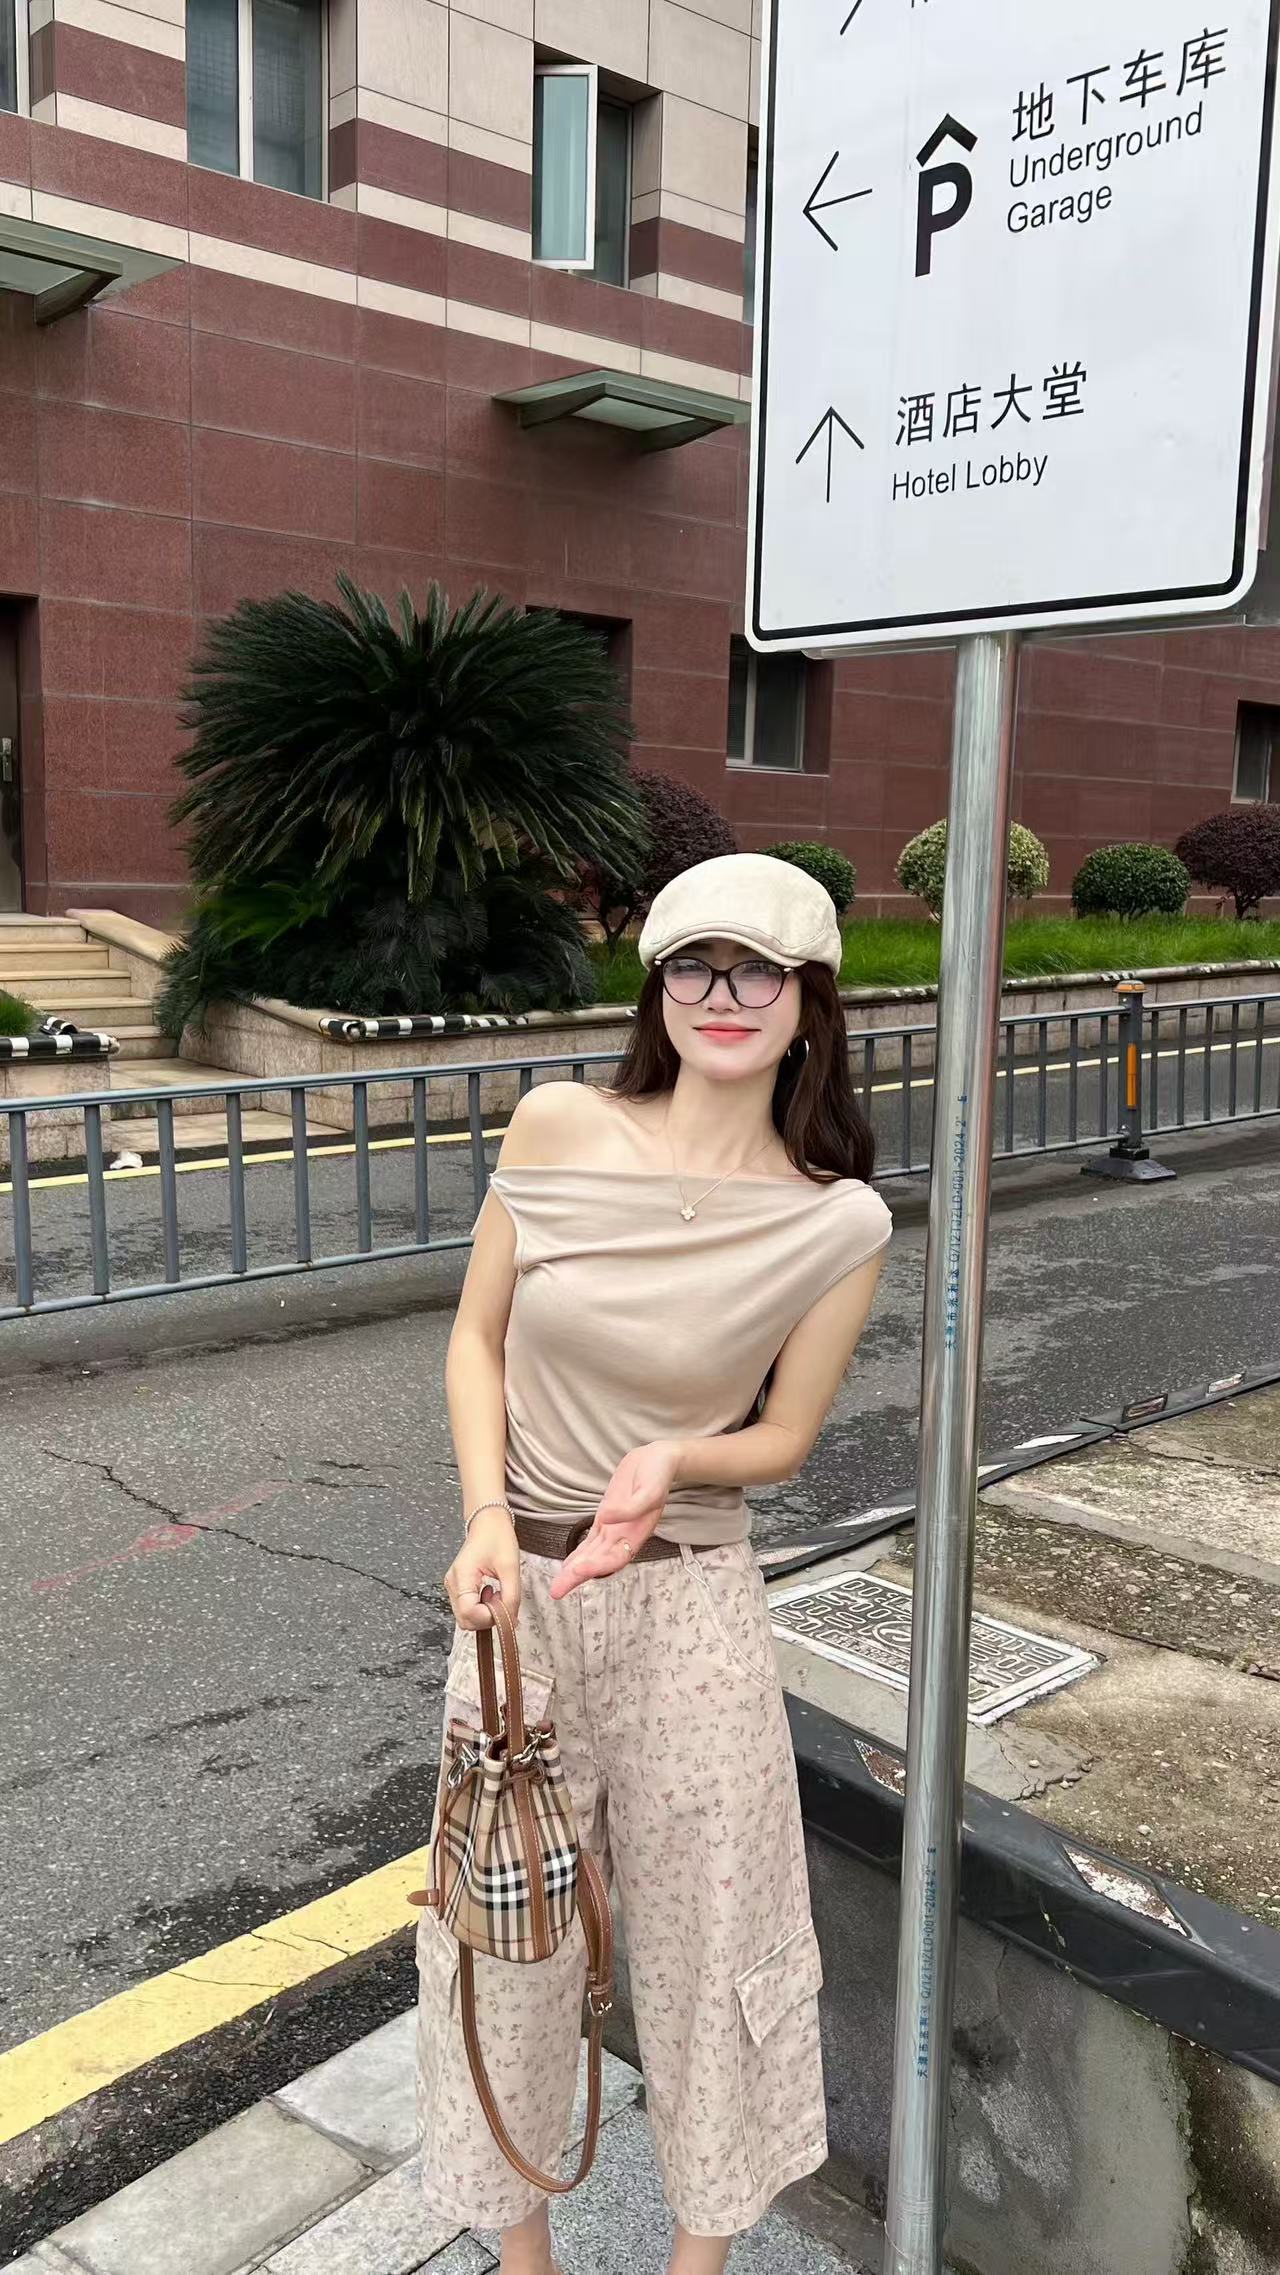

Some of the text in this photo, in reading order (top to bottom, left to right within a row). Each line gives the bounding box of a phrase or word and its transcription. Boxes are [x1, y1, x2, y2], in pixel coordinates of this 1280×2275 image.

[1011, 27, 1229, 142] 地下车库
[1010, 101, 1203, 188] Underground
[915, 163, 973, 278] P
[1007, 185, 1112, 234] Garage
[895, 360, 1087, 446] 酒店大堂
[892, 451, 1048, 501] Hotel Lobby
